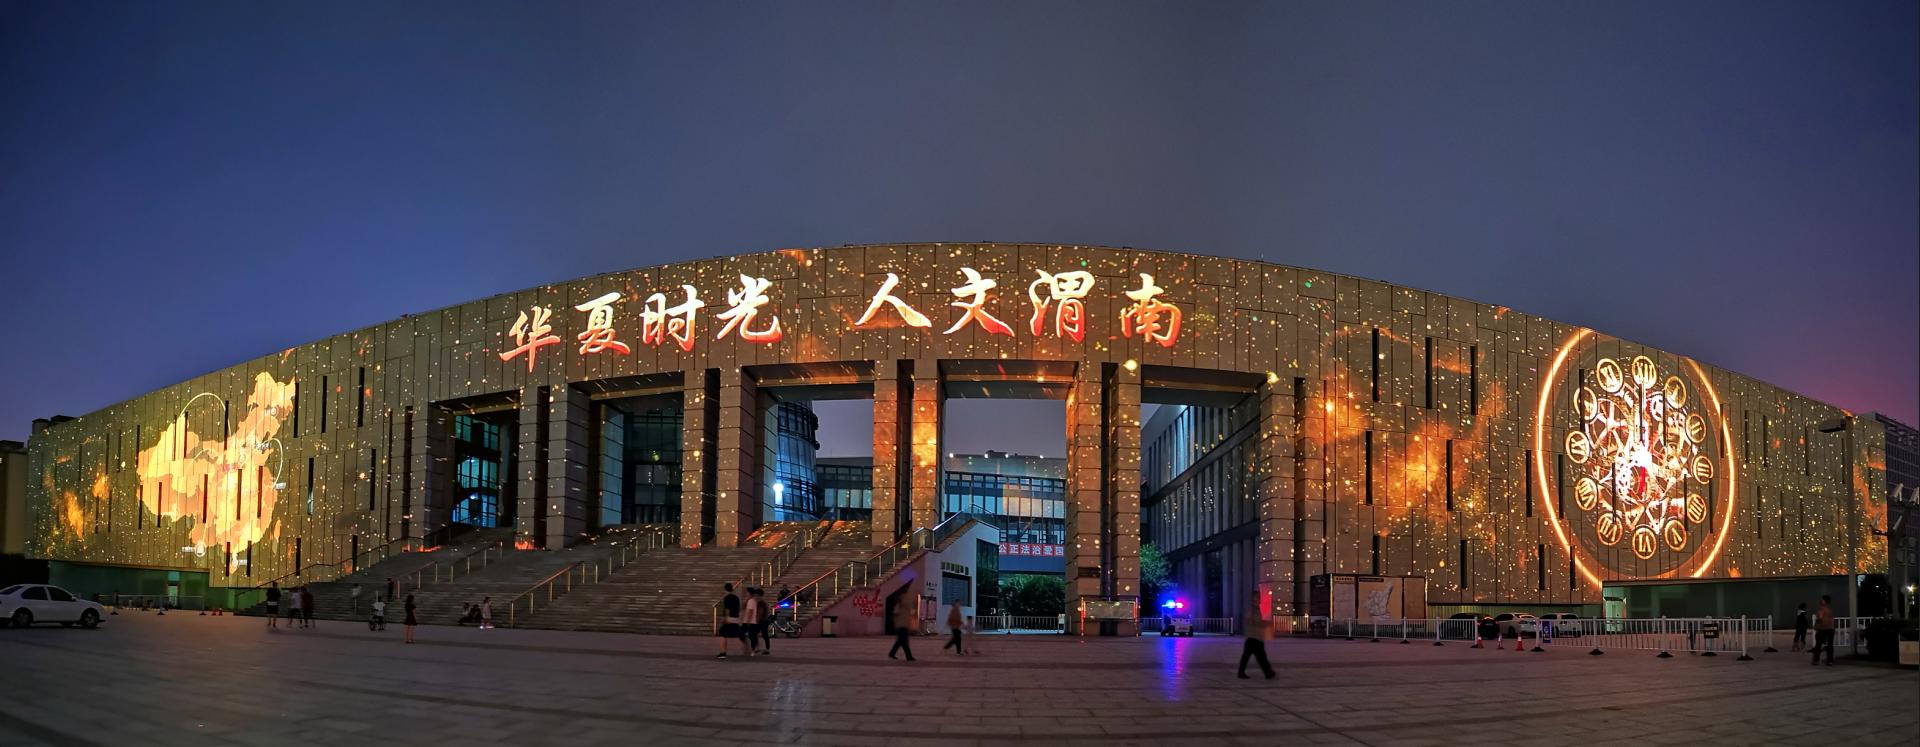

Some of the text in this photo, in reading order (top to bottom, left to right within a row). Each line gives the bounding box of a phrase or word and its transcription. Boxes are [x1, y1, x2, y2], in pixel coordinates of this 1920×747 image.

[499, 266, 1182, 373] 华夏时光 人文渭南
